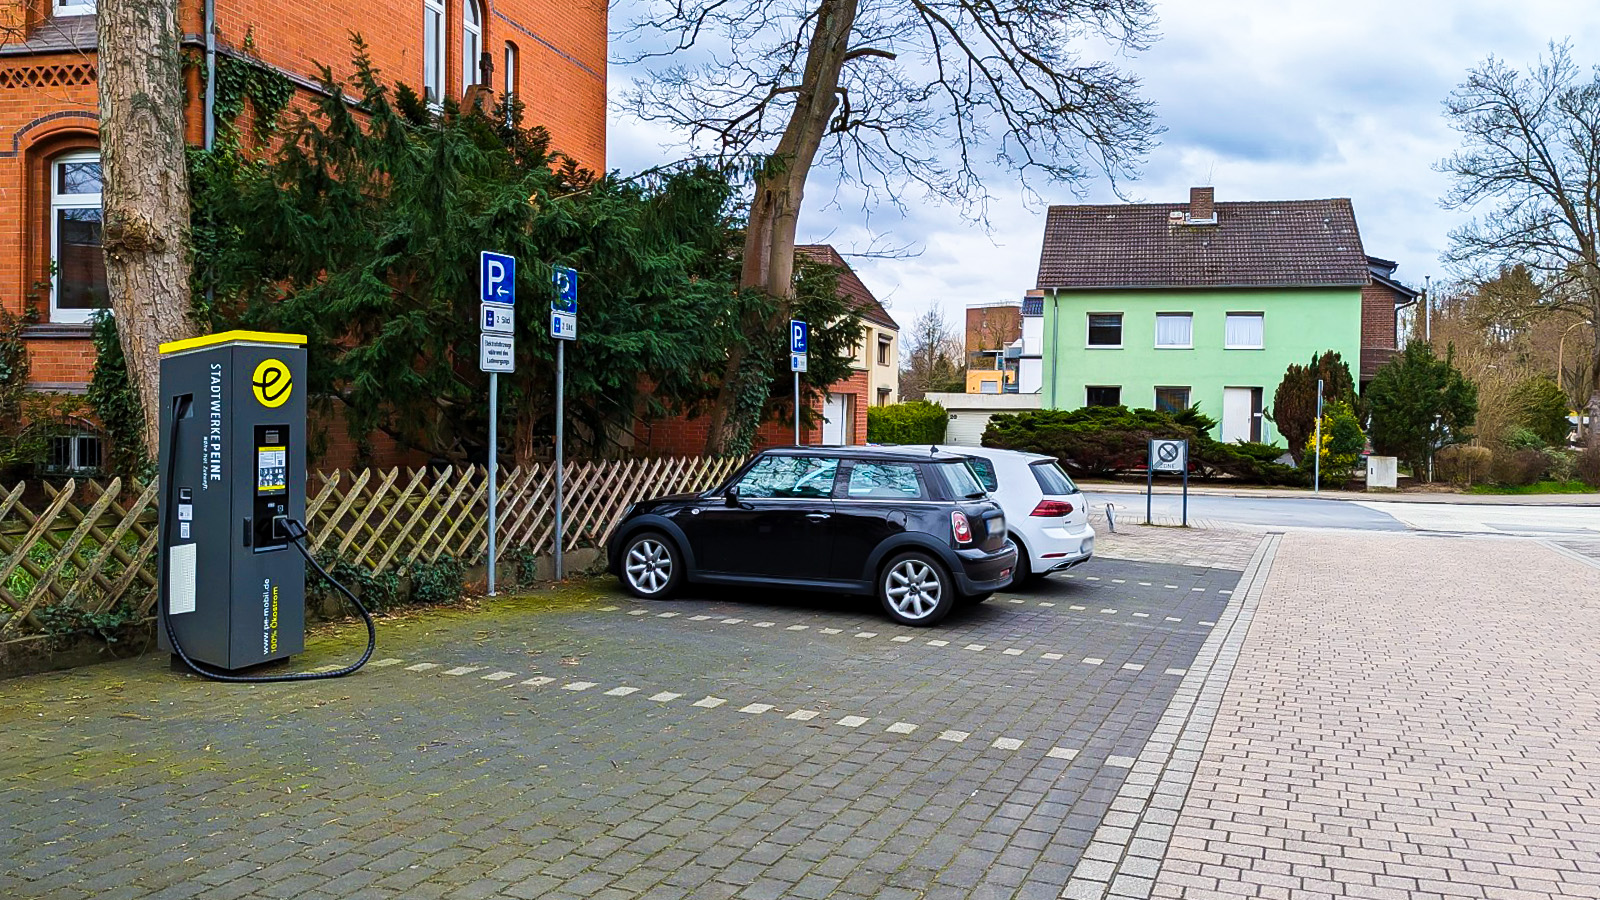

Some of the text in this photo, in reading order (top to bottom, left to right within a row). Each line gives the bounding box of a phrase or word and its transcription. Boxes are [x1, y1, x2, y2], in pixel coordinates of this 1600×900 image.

[488, 260, 505, 296] P
[496, 315, 500, 324] 2
[794, 325, 803, 349] P
[210, 363, 222, 481] STADTWERKE PEINE
[270, 586, 279, 629] Ökostrom
